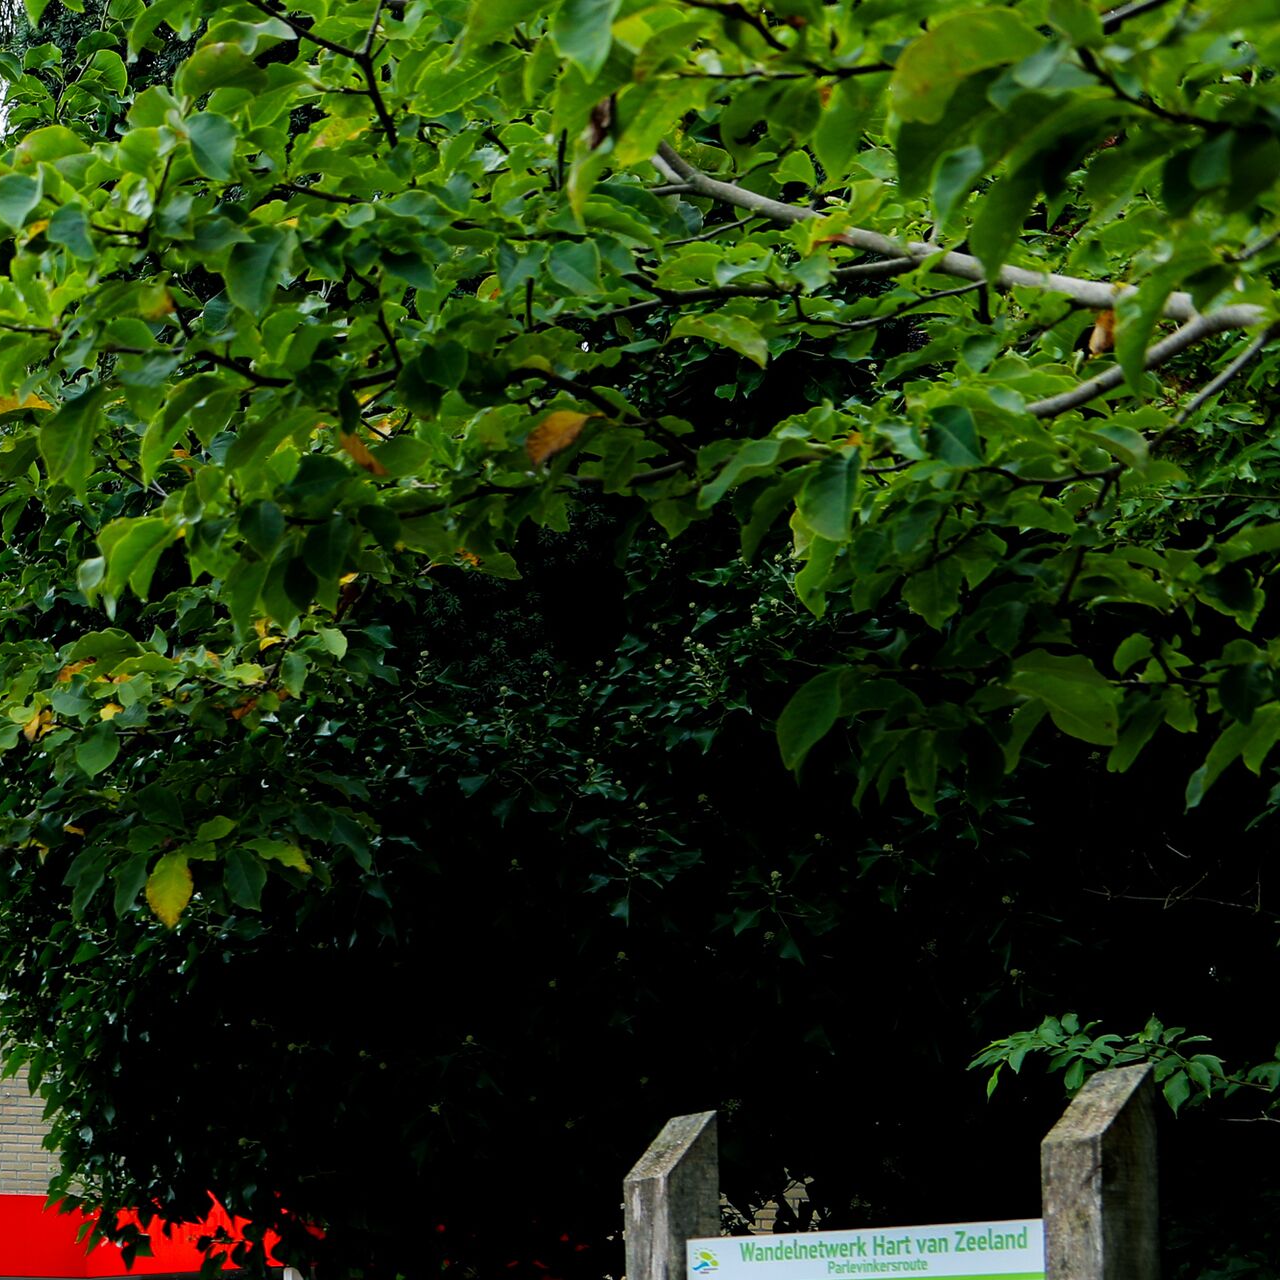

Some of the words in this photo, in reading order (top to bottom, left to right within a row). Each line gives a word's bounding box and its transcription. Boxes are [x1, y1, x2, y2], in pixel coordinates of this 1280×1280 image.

[740, 1235, 868, 1262] Wandelnetwerk
[872, 1235, 911, 1256] Hart
[916, 1237, 948, 1254] van
[954, 1226, 1028, 1252] Zeeland
[828, 1258, 929, 1274] Parlevinkersroute
